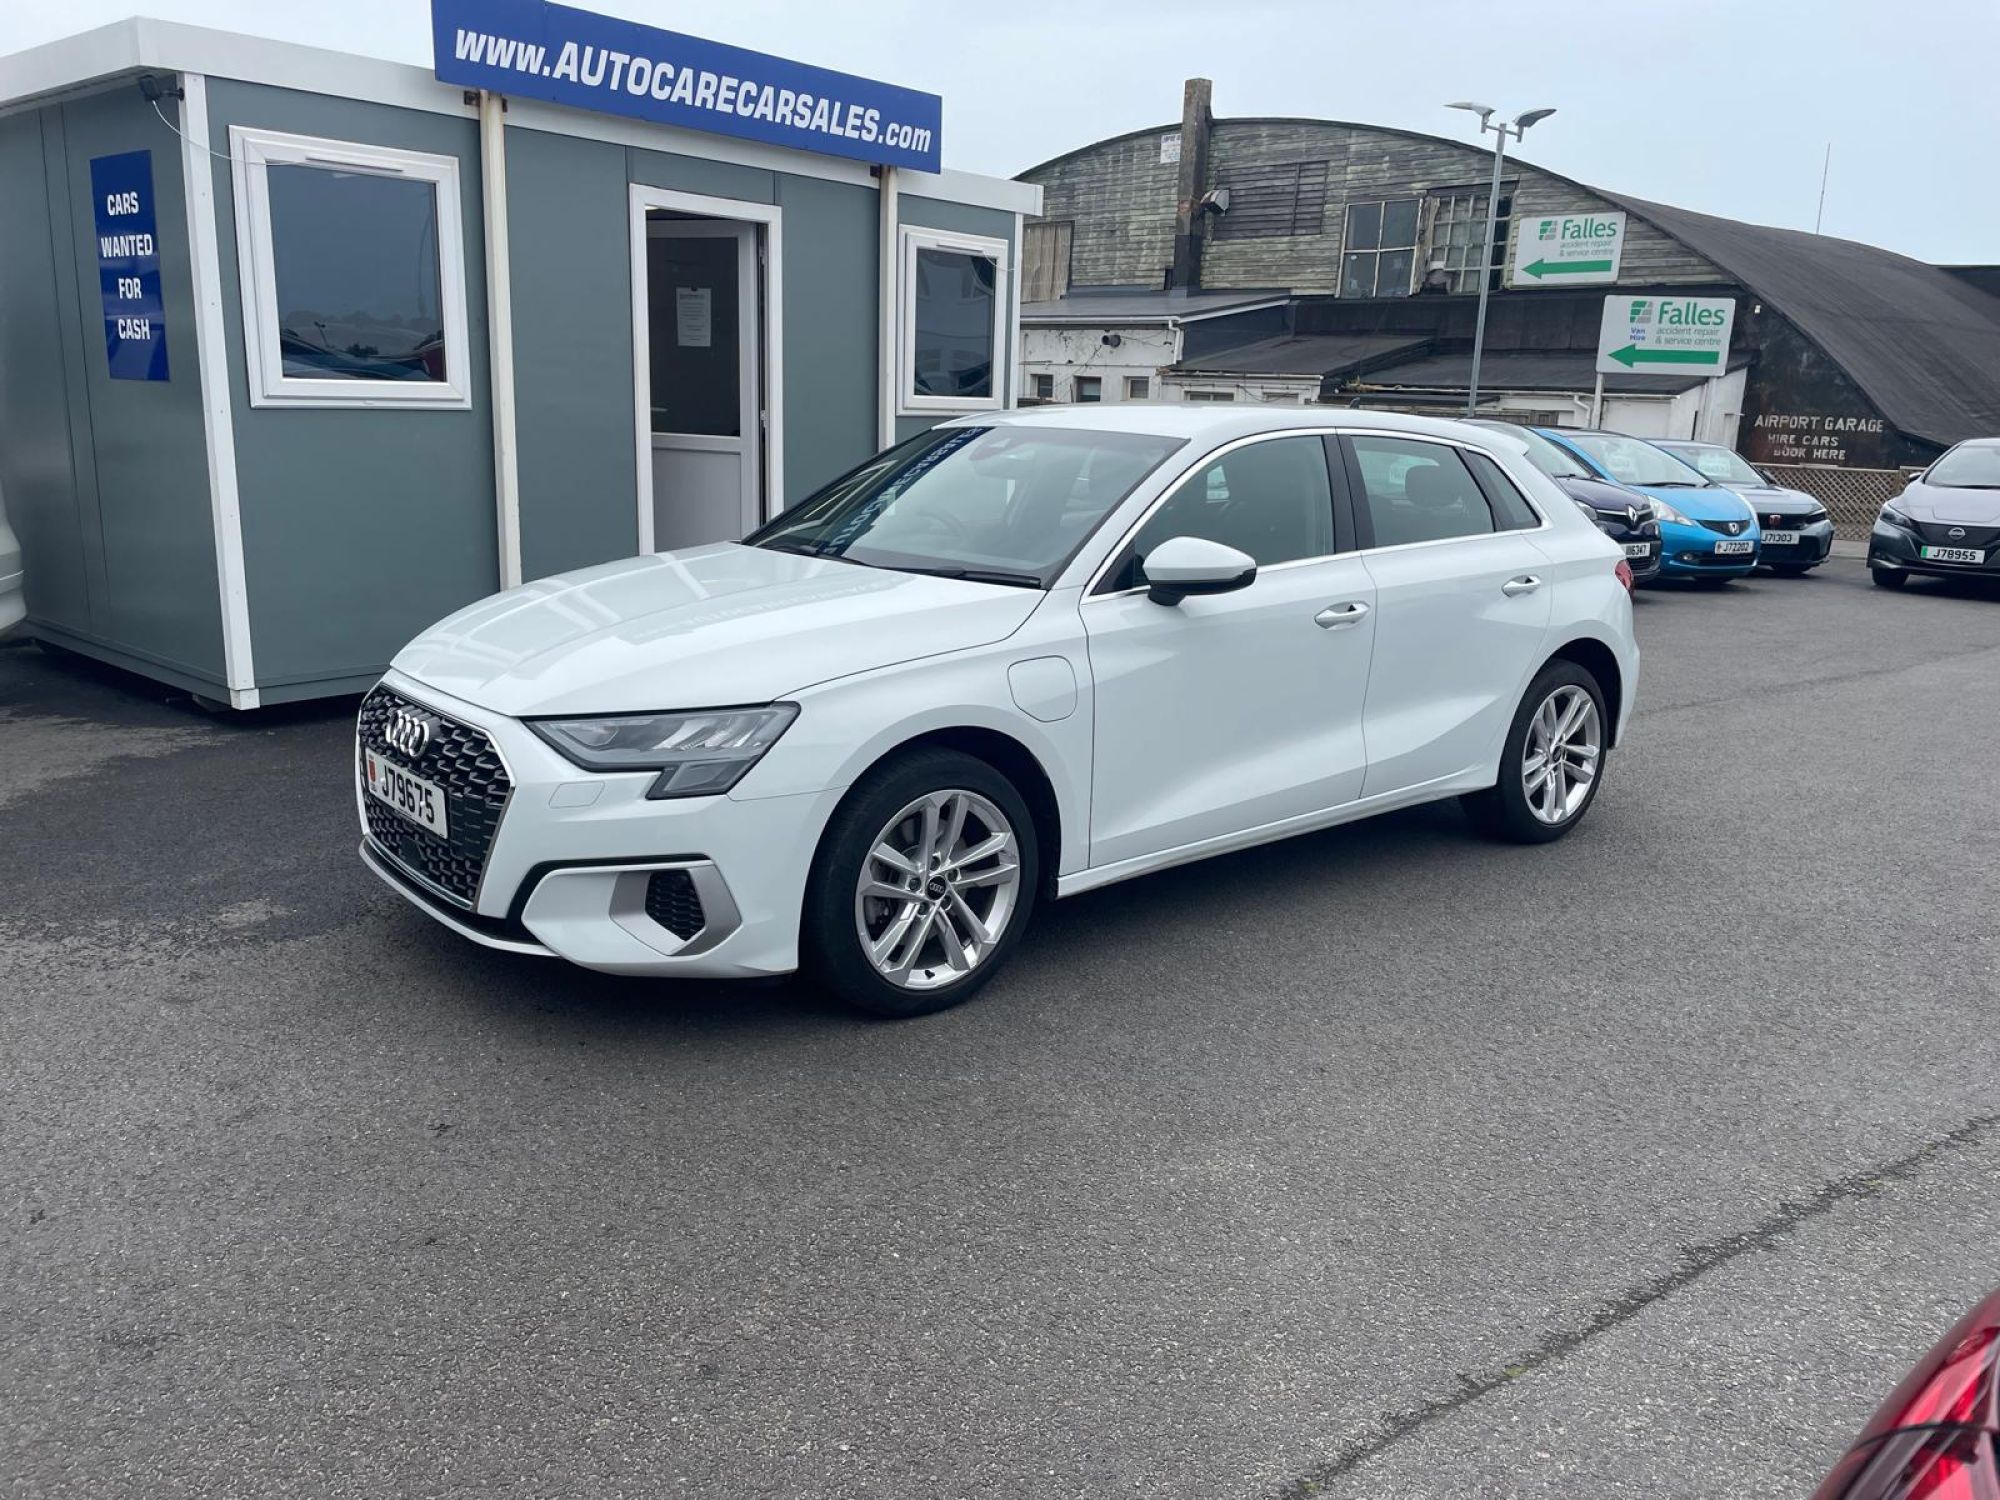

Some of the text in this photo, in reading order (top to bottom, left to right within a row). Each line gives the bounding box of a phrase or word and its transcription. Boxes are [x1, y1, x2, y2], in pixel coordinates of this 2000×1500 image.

[106, 191, 140, 216] CARS
[1561, 218, 1617, 240] Falles
[100, 234, 153, 258] WANTED
[118, 278, 142, 299] FOR
[1658, 301, 1726, 326] Falles
[118, 319, 150, 340] CASH
[1631, 327, 1646, 335] Van
[1656, 326, 1720, 337] accident repair
[1664, 336, 1692, 345] service
[1694, 337, 1721, 346] centre
[1754, 414, 1884, 433] AIRPORT GARAGE
[1768, 434, 1839, 446] HIRE CARS
[1813, 449, 1846, 460] HERE
[1933, 548, 1977, 561] J78955
[382, 764, 435, 824] J79675
